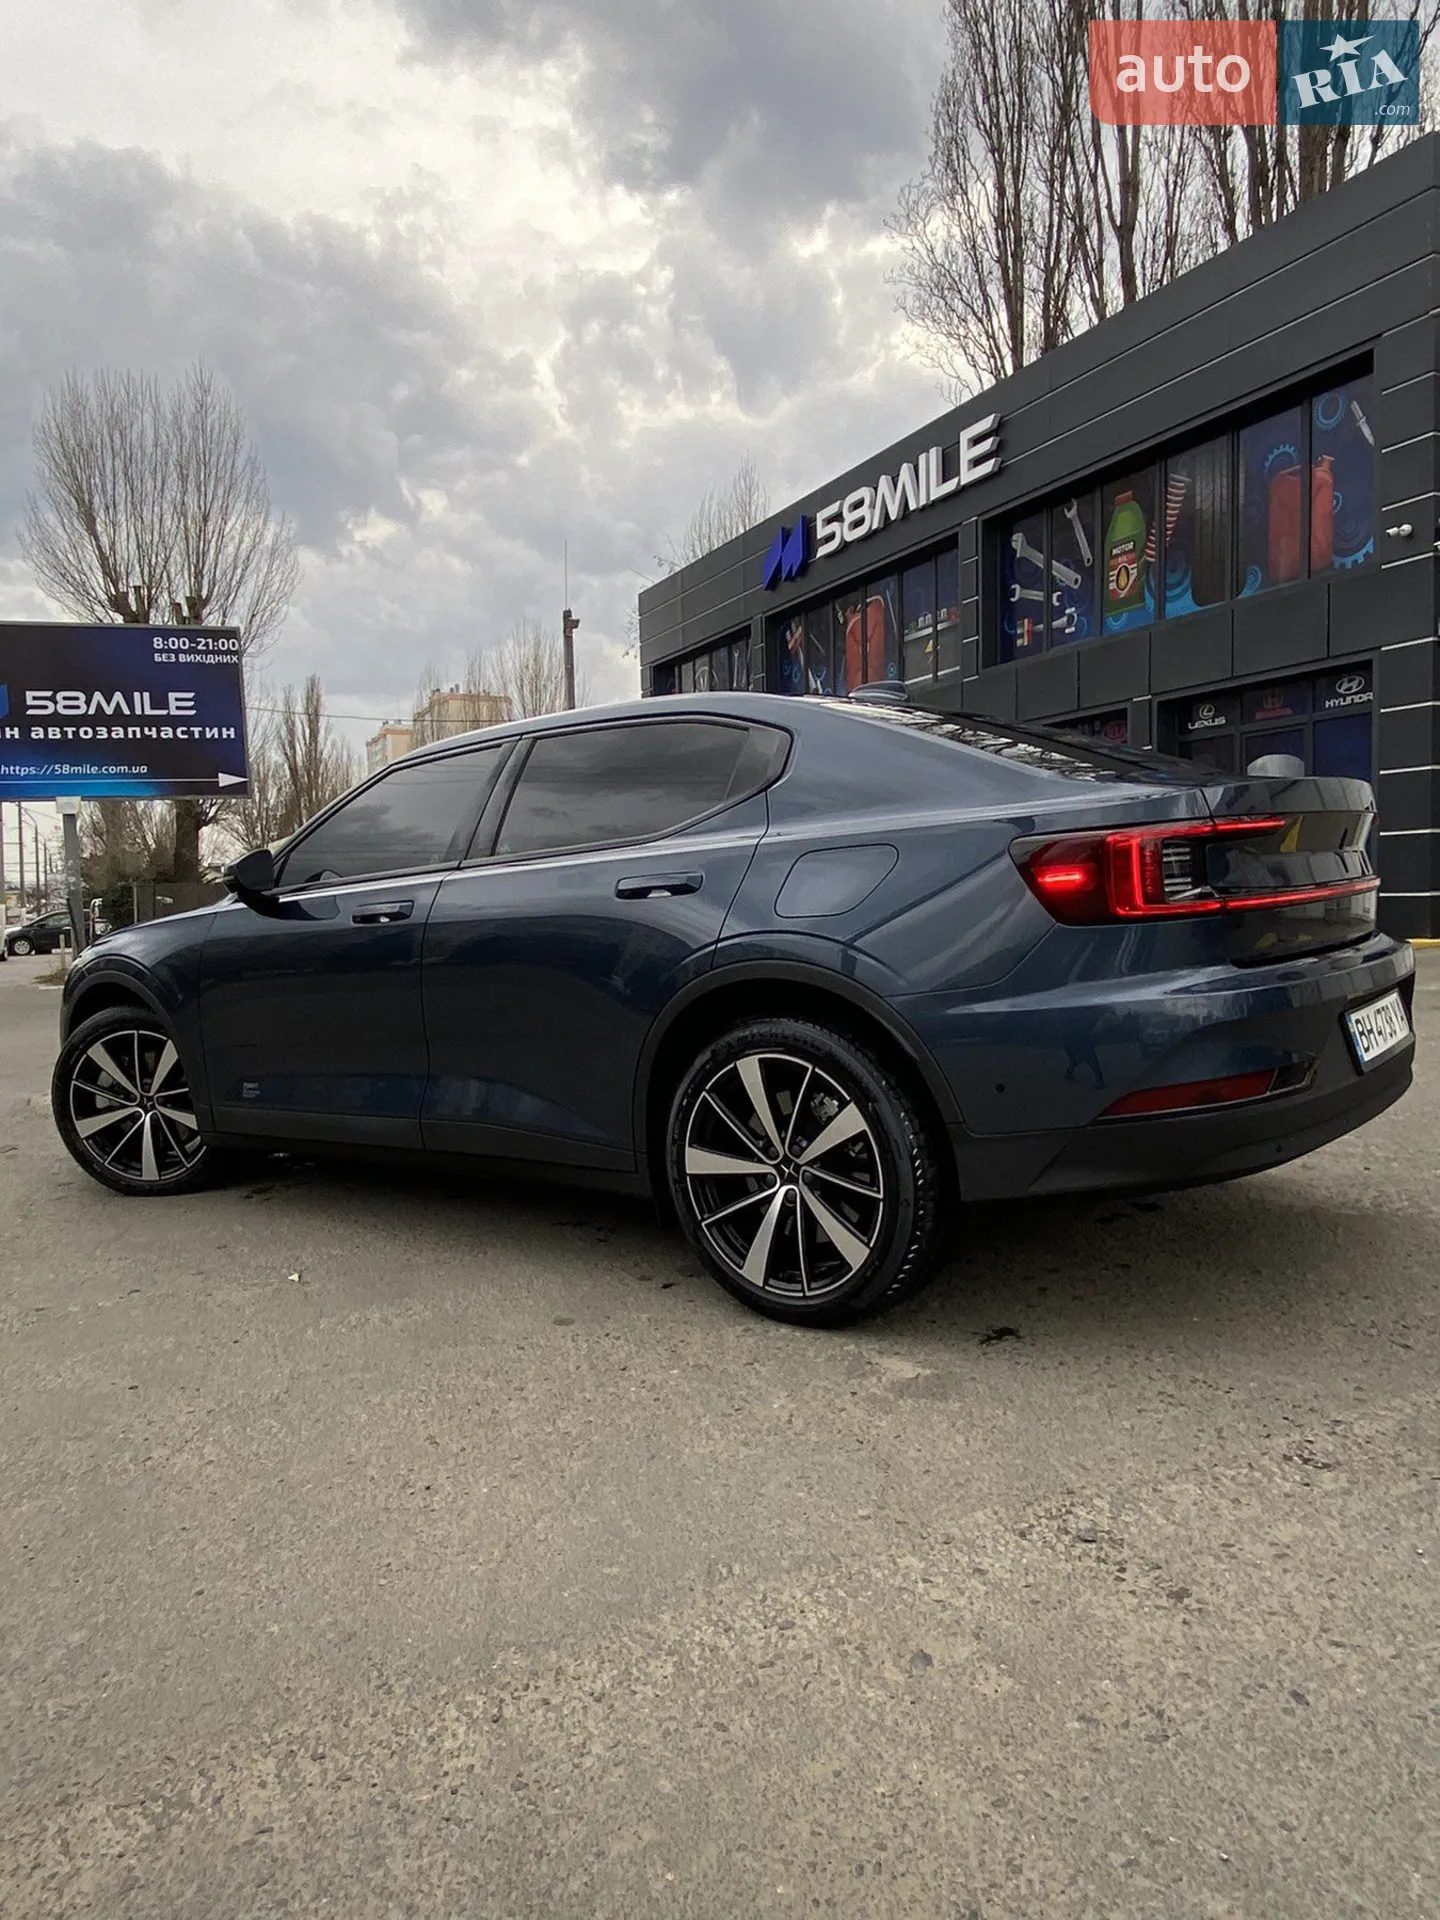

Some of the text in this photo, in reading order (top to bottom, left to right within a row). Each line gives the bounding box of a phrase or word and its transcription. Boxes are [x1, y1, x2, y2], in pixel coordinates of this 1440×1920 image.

[815, 412, 1002, 560] 58MILE
[152, 636, 239, 651] 8:00-21:00
[154, 653, 239, 664] БЕЗ ВИХІДНИХ
[25, 690, 197, 716] 58MILE
[1325, 692, 1374, 708] HYUNDA
[1188, 716, 1226, 730] LEXUS
[30, 726, 237, 740] автозапчастин
[0, 763, 148, 777] https://58mile.com.ua
